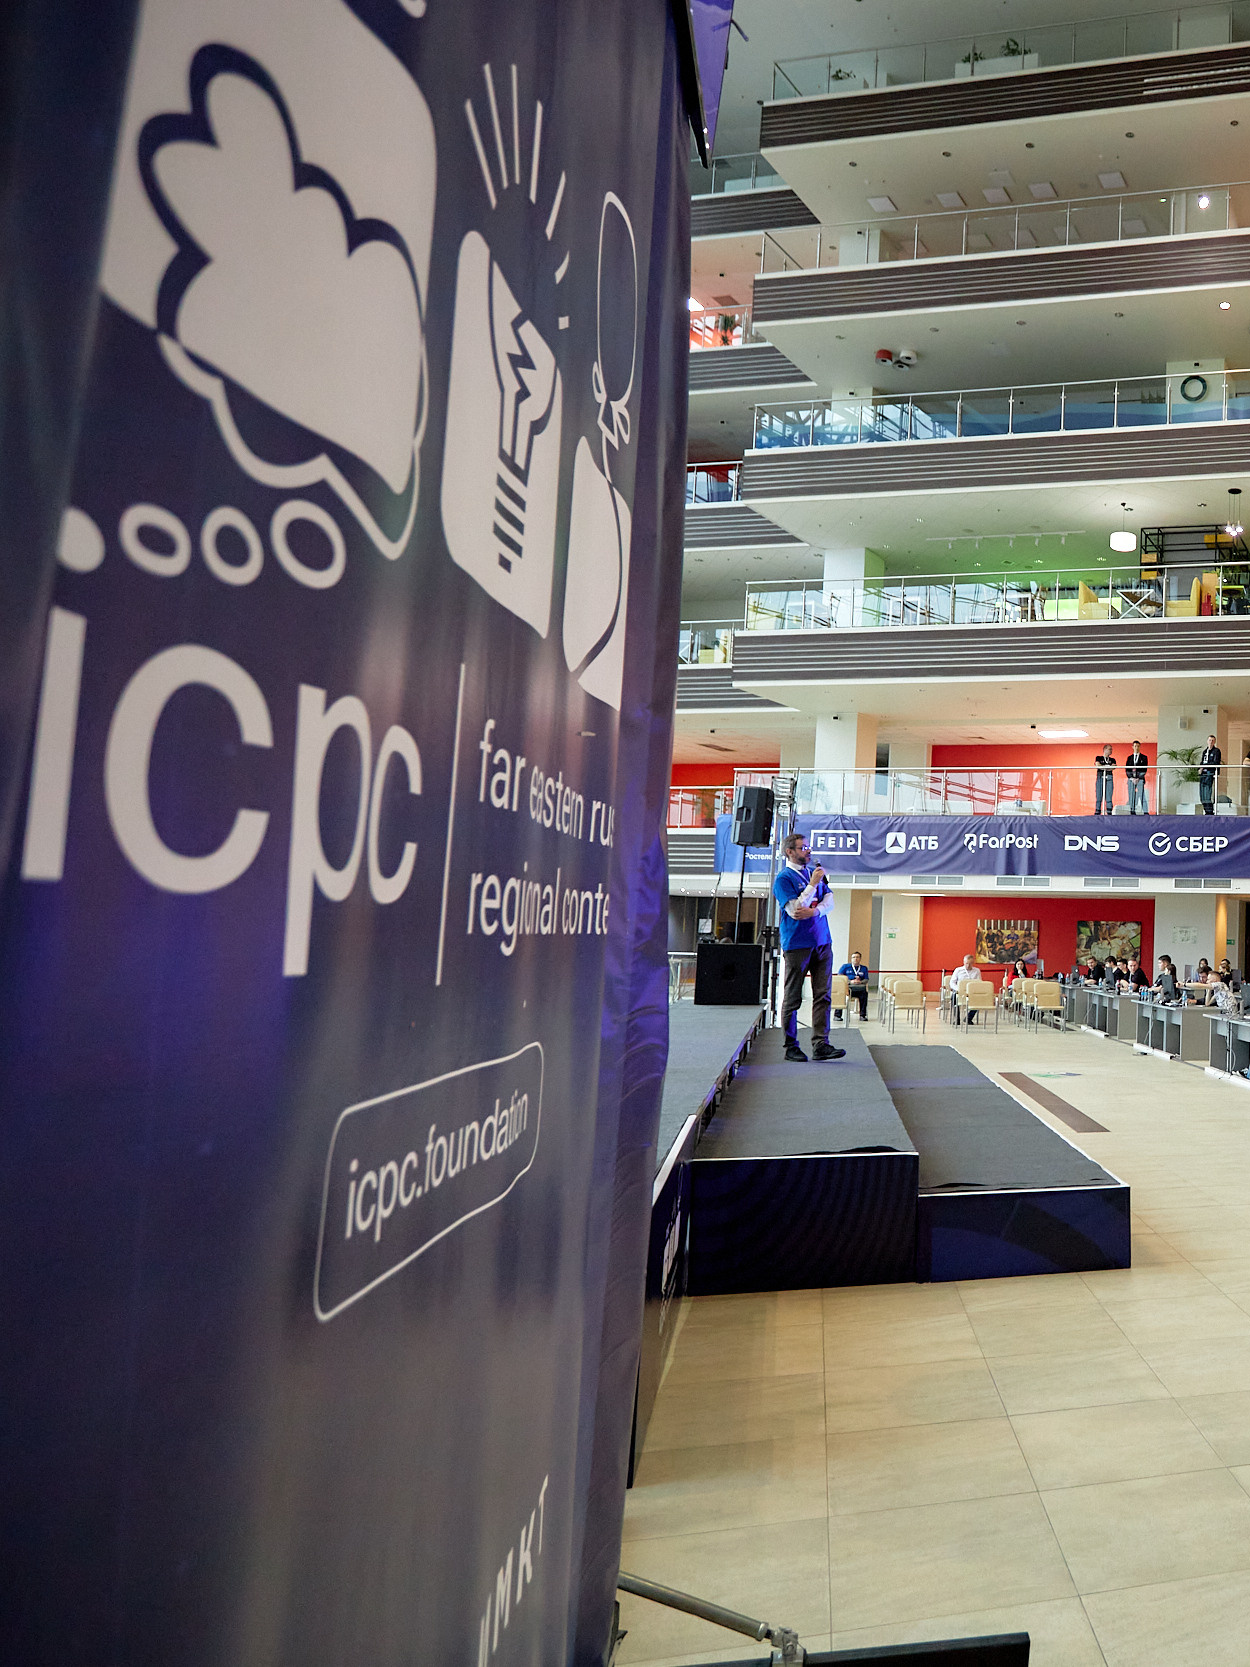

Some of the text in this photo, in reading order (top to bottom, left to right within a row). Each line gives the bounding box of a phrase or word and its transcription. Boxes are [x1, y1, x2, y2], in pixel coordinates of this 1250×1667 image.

[20, 506, 422, 977] icpc
[479, 718, 526, 812] far
[529, 765, 584, 839] eastern
[816, 836, 855, 849] FEIP
[907, 836, 939, 850] АТБ
[979, 834, 1039, 849] FarPost
[1064, 835, 1120, 852] DNS
[1175, 836, 1229, 852] СБЕР
[467, 861, 561, 956] regional
